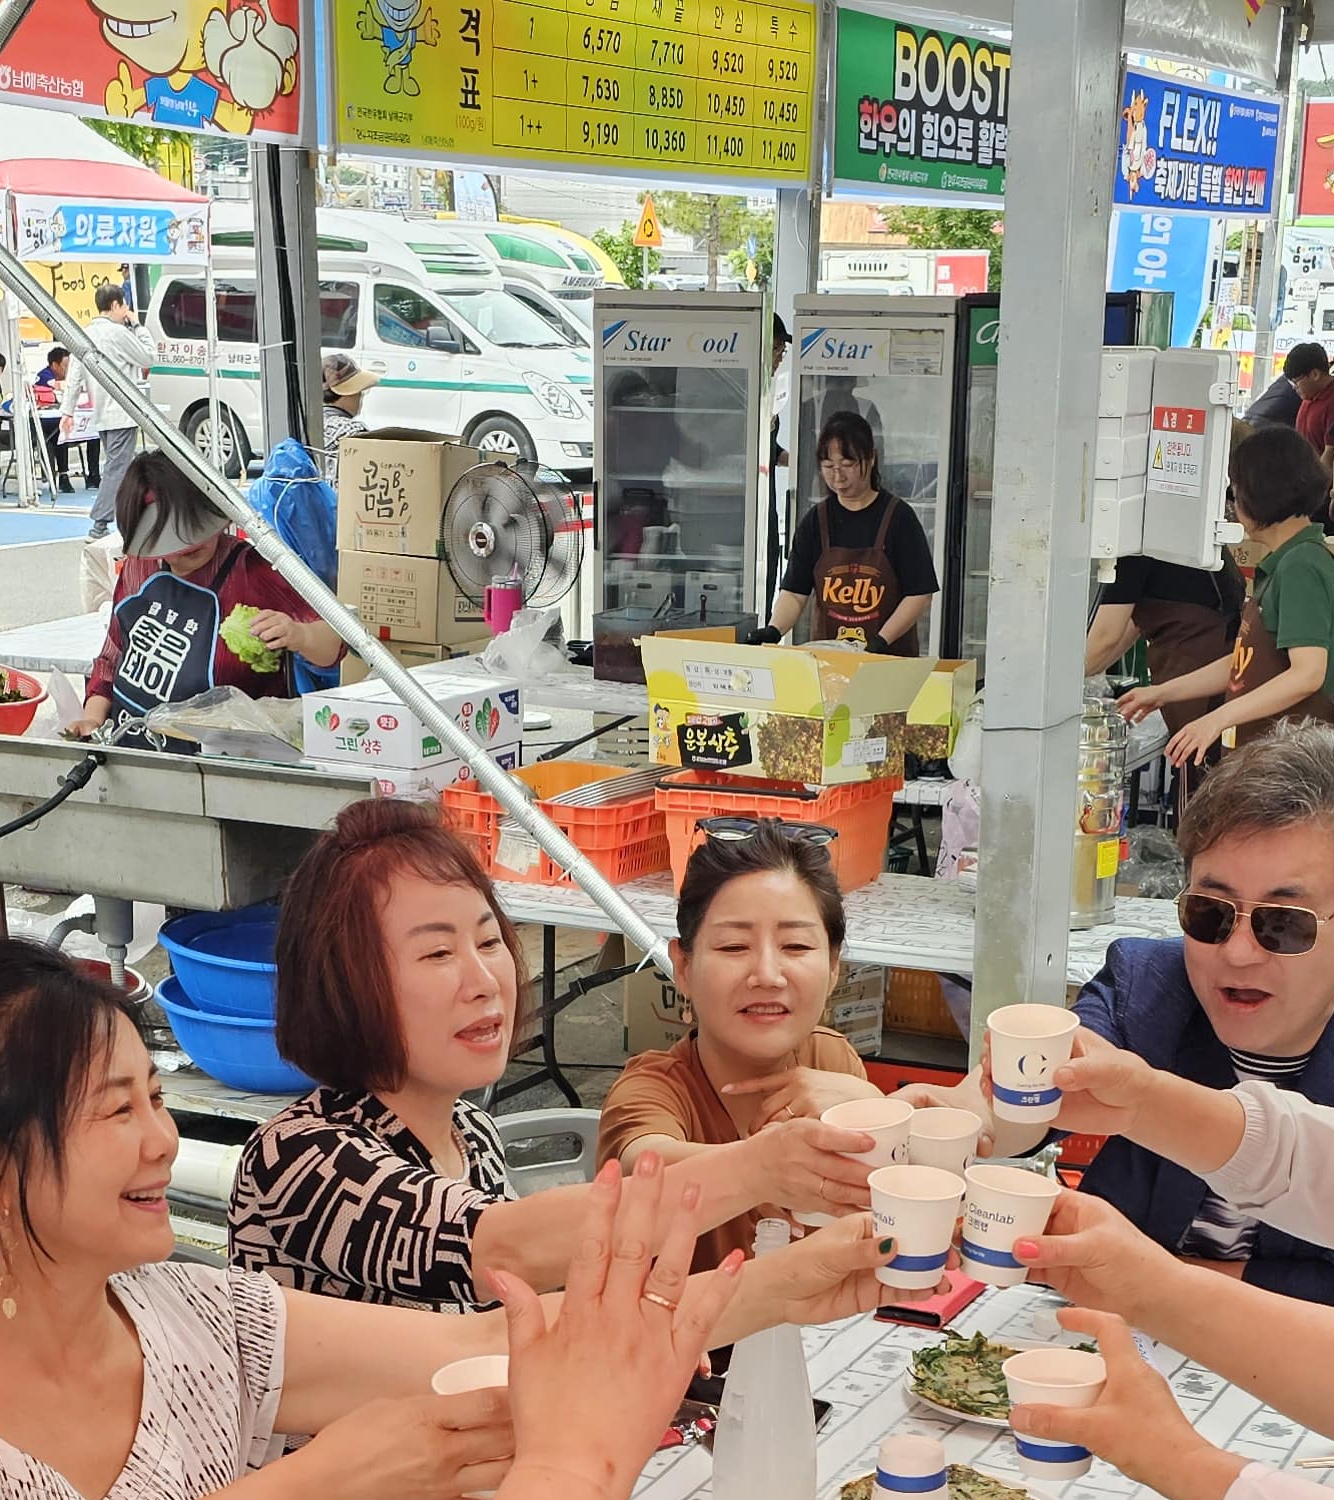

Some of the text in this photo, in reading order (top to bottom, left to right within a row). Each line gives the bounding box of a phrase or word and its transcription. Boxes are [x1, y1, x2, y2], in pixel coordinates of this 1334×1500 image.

[529, 17, 798, 82] 1 6,570 7,710 9,520 9,520
[523, 69, 798, 124] 1+ 7,630 8,850 10,450 10,450
[895, 31, 1011, 117] BOOST
[519, 114, 796, 164] 1++ 9,190 10,360 11,400 11,400
[859, 100, 917, 155] 한우의
[922, 111, 974, 161] 힘으로
[1159, 91, 1221, 156] FLEX!!
[1155, 158, 1200, 203] 축제기념
[1200, 164, 1223, 205] 특별
[1223, 166, 1245, 205] 할인
[73, 213, 157, 249] 의료지원
[624, 330, 739, 354] Star Cool
[821, 337, 873, 360] Star
[822, 576, 886, 613] Kelly
[335, 736, 382, 755] 그린 상추
[683, 726, 740, 760] 운봉상추
